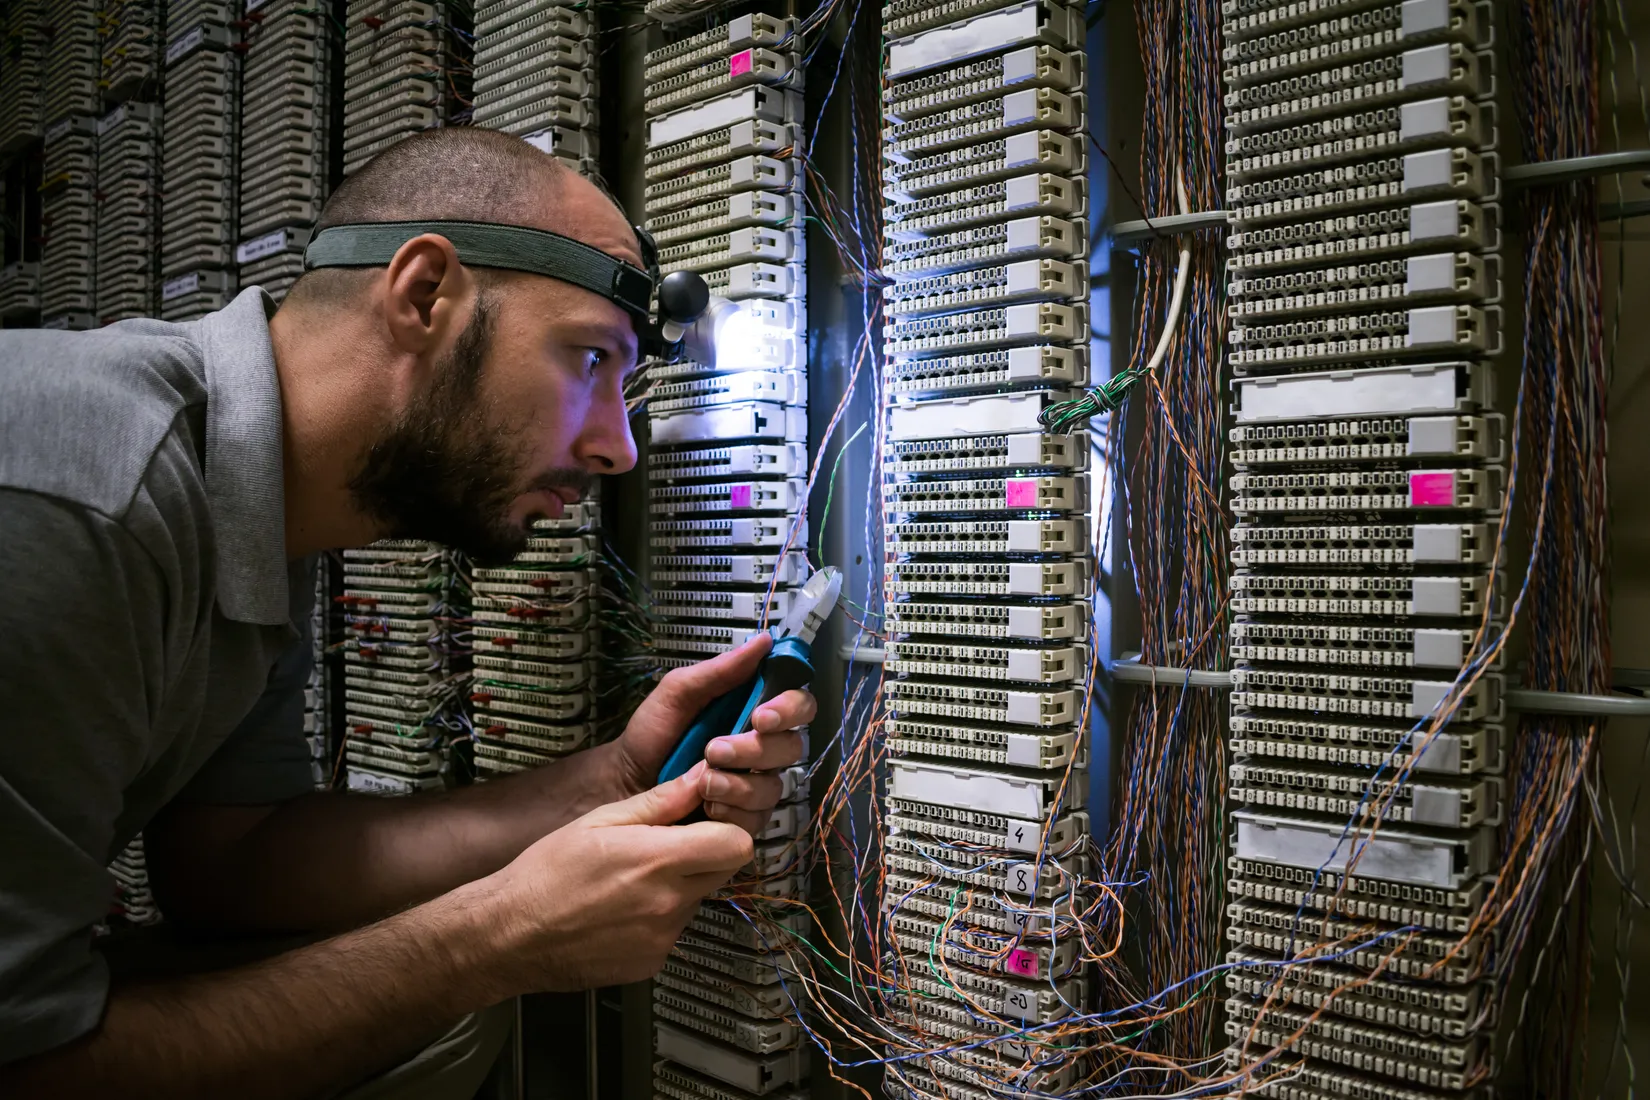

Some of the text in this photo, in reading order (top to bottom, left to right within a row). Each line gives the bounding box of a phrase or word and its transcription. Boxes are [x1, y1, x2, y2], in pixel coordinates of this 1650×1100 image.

[1015, 827, 1024, 843] 4
[1017, 870, 1027, 891] 8
[737, 996, 752, 1012] 28
[1010, 994, 1028, 1009] 20
[738, 1028, 754, 1050] 32
